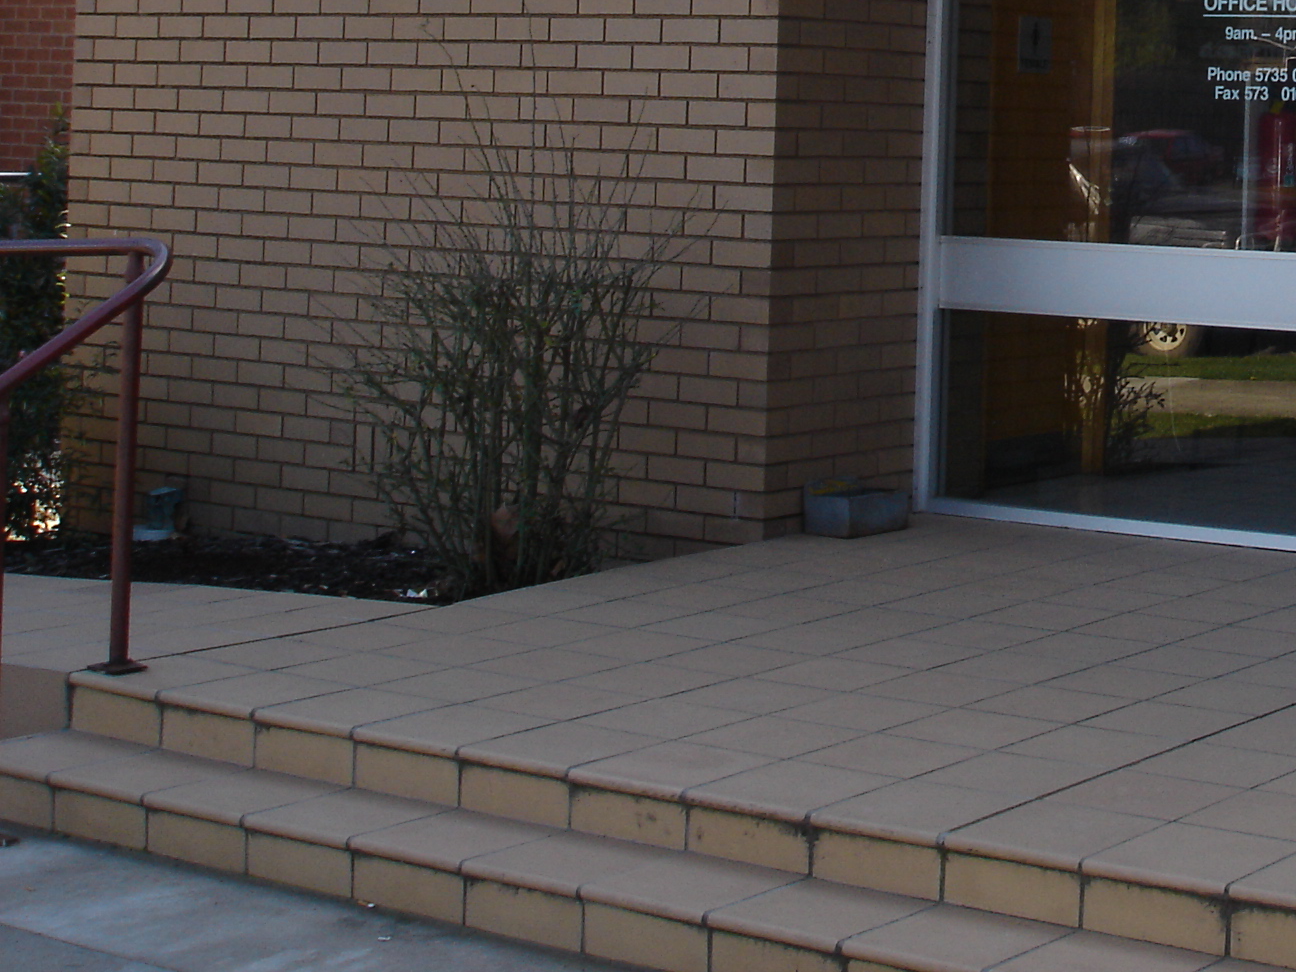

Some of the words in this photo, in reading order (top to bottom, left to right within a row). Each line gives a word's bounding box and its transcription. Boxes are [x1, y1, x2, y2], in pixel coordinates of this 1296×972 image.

[1207, 67, 1251, 82] Phone
[1255, 68, 1288, 82] 5735
[1214, 86, 1240, 100] Fax
[1244, 87, 1269, 101] 573
